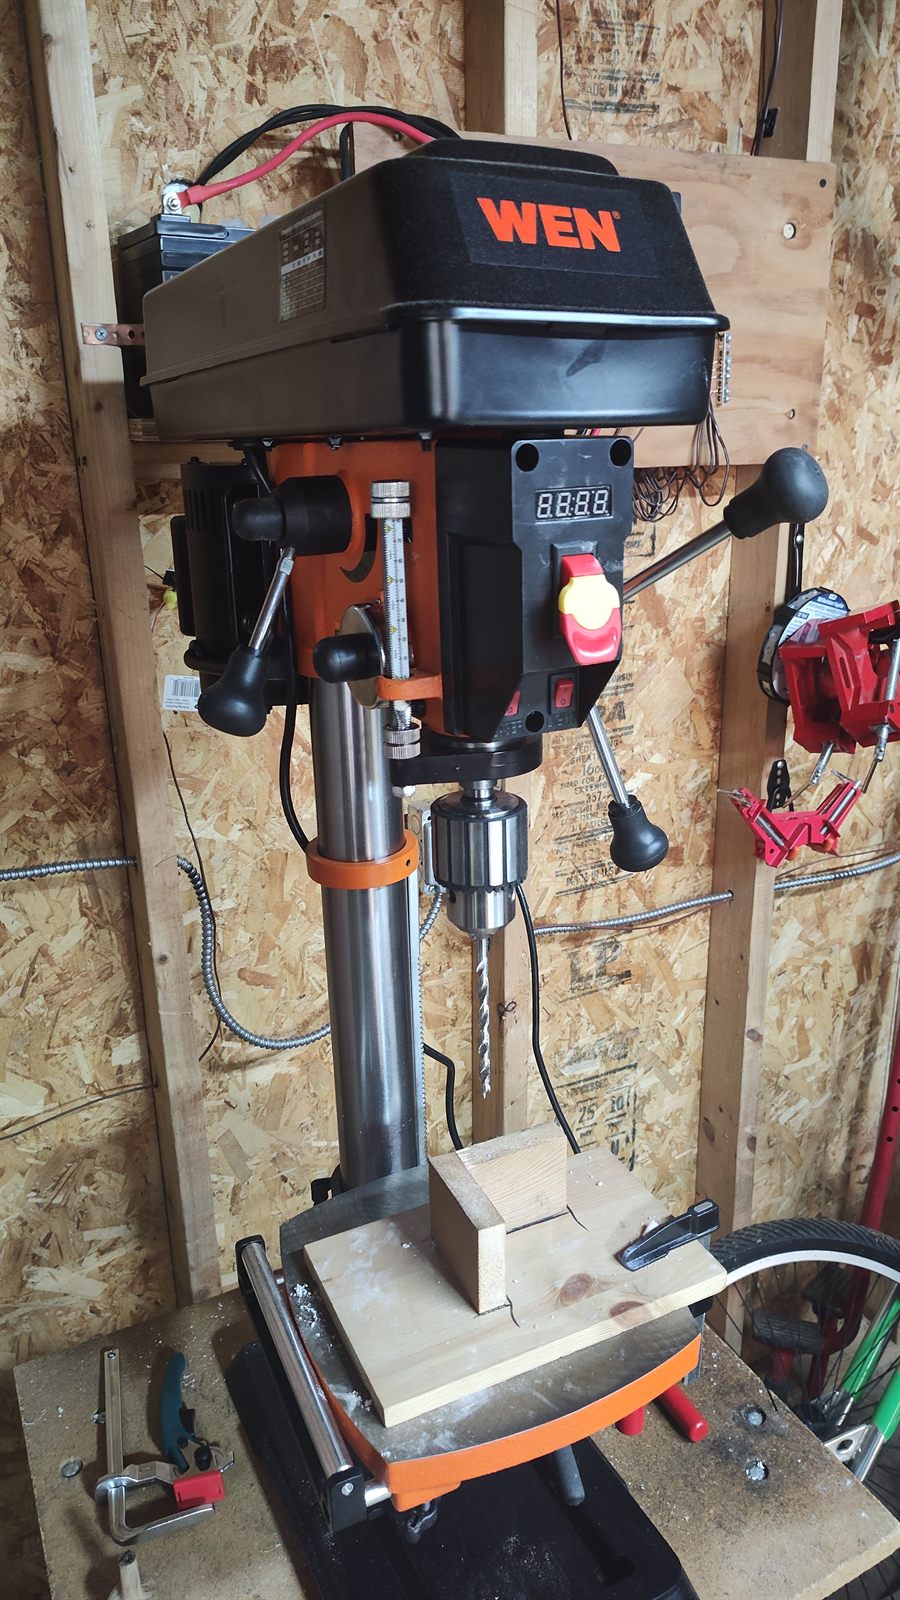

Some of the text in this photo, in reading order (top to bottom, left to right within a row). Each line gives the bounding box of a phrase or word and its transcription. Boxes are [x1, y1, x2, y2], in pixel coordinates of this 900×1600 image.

[476, 197, 621, 252] WEN
[579, 1094, 625, 1124] 25 10
